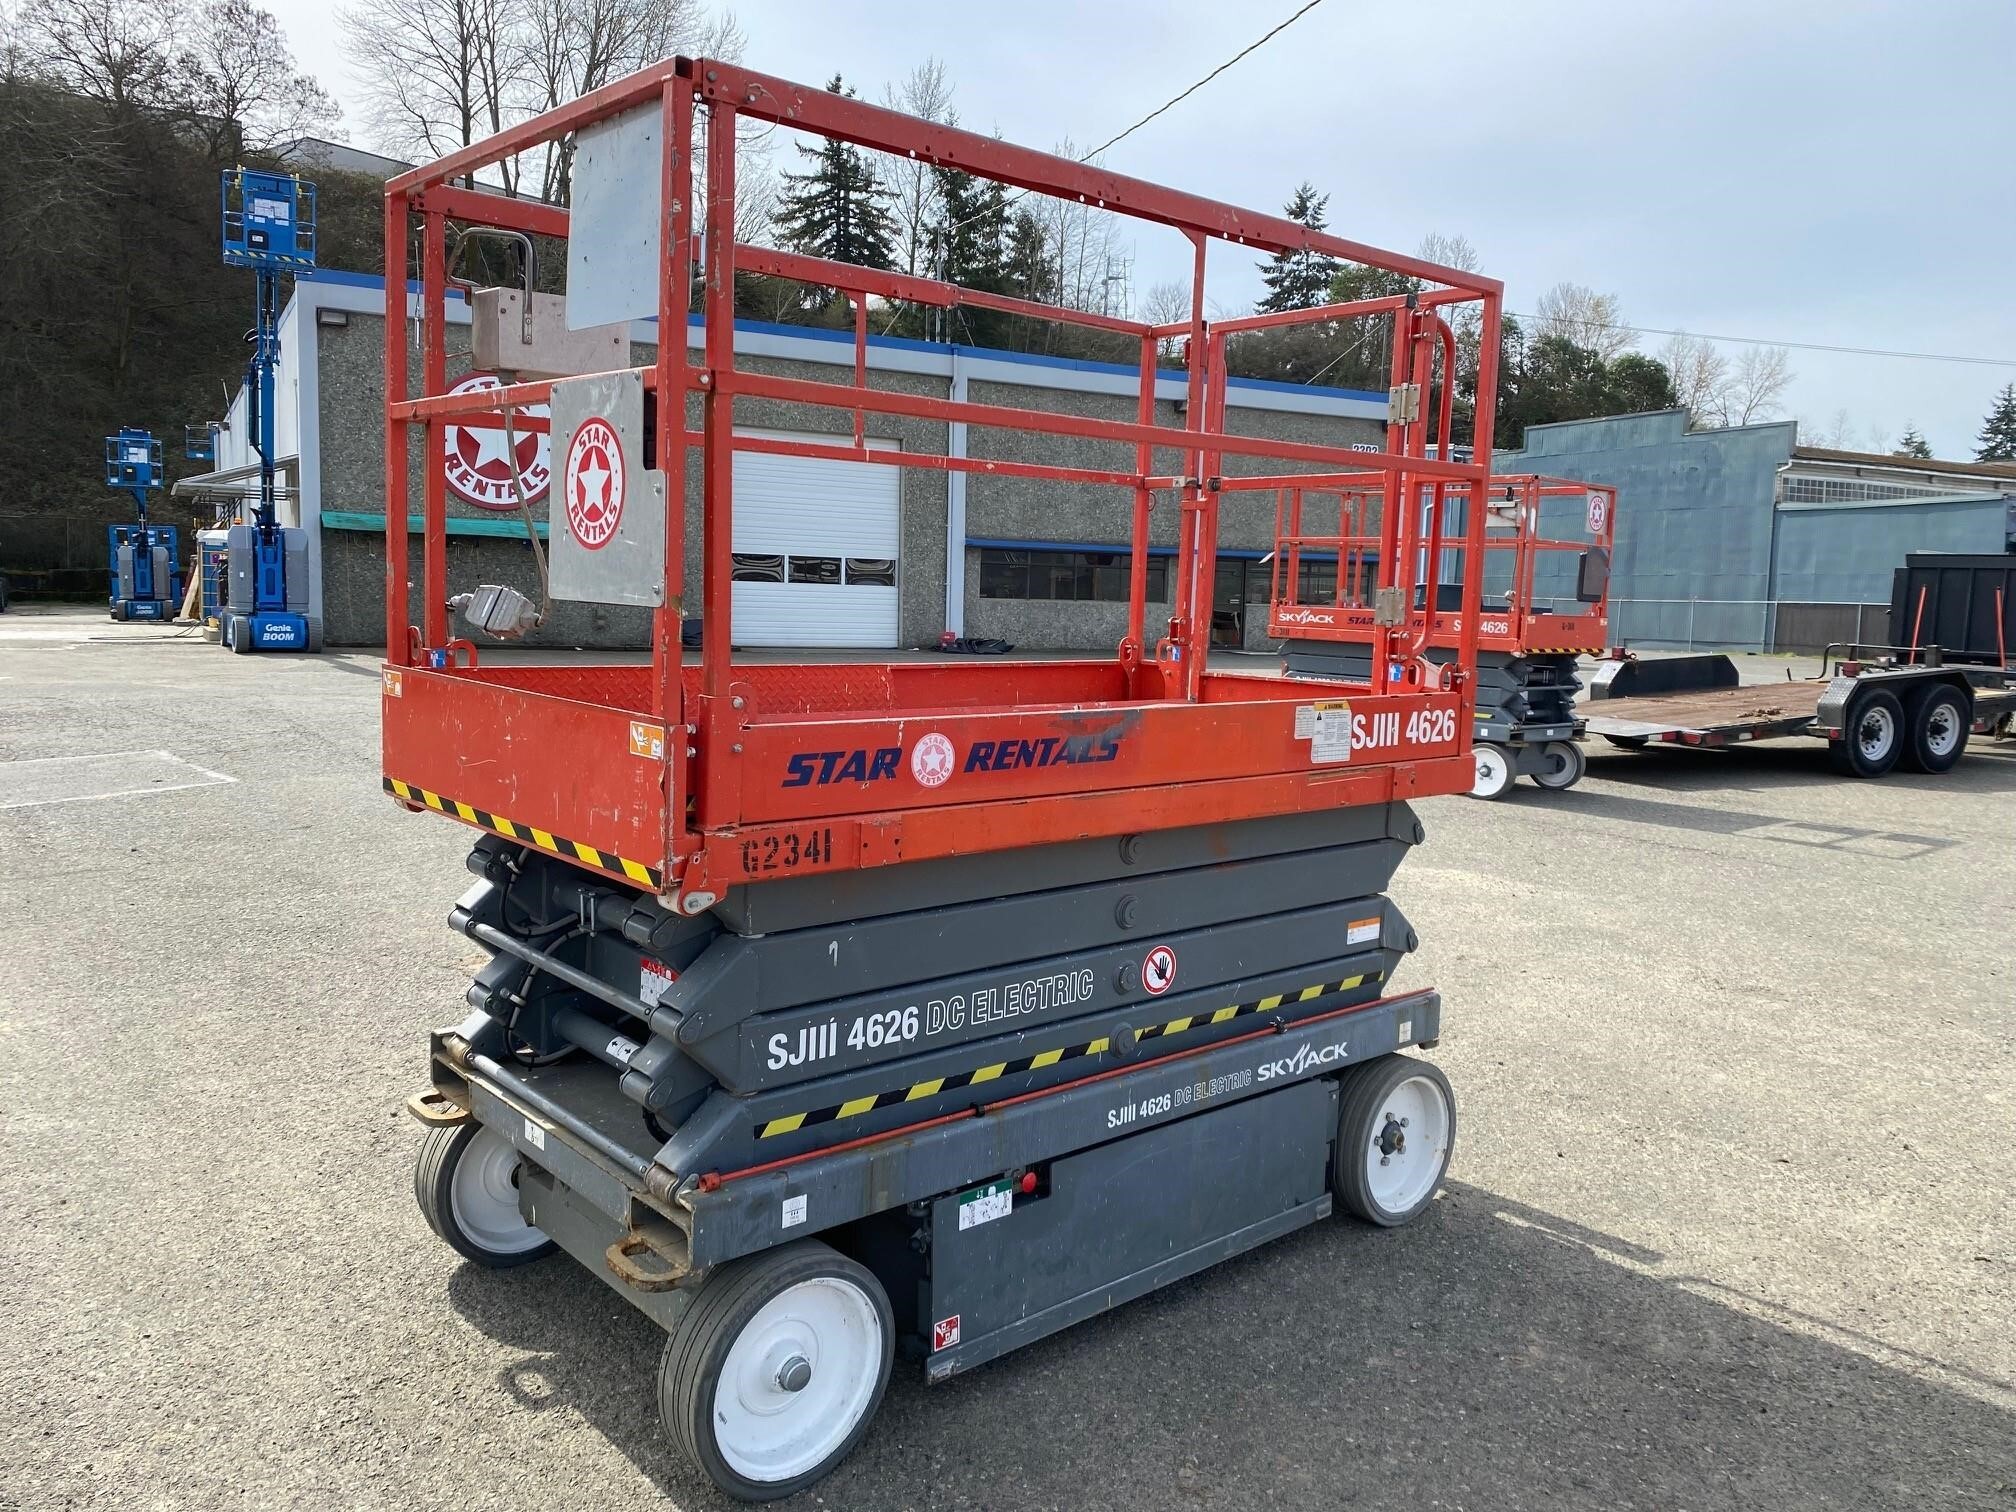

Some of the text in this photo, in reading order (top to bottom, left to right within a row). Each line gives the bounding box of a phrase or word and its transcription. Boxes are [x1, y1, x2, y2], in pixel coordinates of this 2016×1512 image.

[579, 427, 609, 452] STAR
[446, 453, 549, 500] RENTALS
[570, 500, 618, 541] RENTALS
[265, 623, 292, 632] Genie
[1279, 609, 1335, 625] SKYJACK
[1347, 616, 1375, 625] STAR
[1480, 621, 1508, 634] 4626
[262, 632, 295, 641] BOOM
[1351, 713, 1400, 750] SJIII
[1405, 709, 1455, 744] 4626
[922, 736, 946, 747] STAR
[781, 737, 1119, 788] STAR RENTALS
[916, 766, 951, 785] RENTALS
[767, 968, 1094, 1071] SJIII 4626 DC ELECTRIC
[1107, 1042, 1349, 1128] SJIII 4626 DC ELECTRIC SKYJACK
